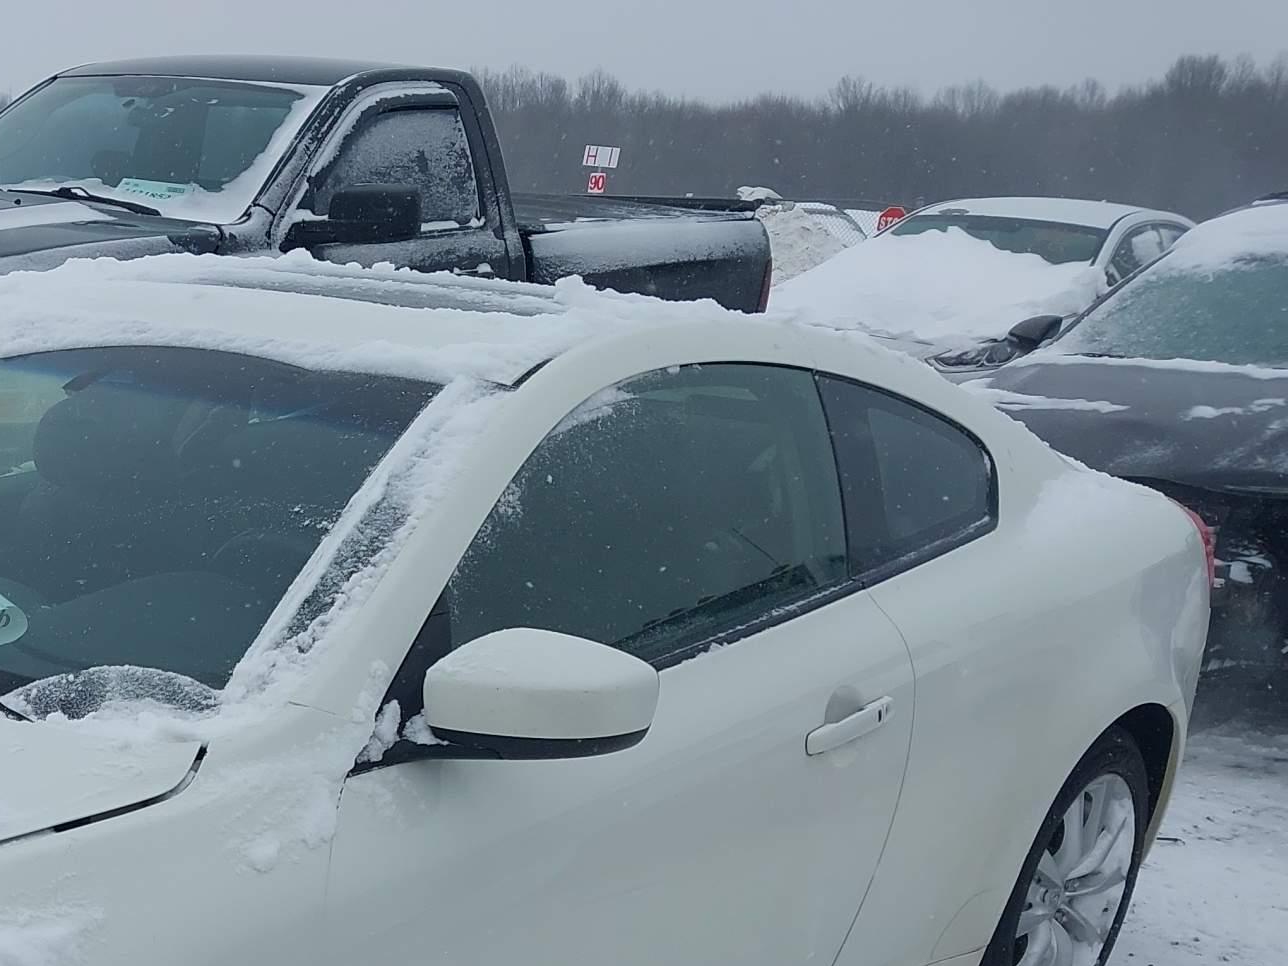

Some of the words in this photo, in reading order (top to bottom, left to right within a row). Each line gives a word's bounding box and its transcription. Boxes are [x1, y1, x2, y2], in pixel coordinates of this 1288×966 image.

[586, 146, 598, 165] H
[589, 175, 604, 190] 90
[879, 216, 899, 229] ST
